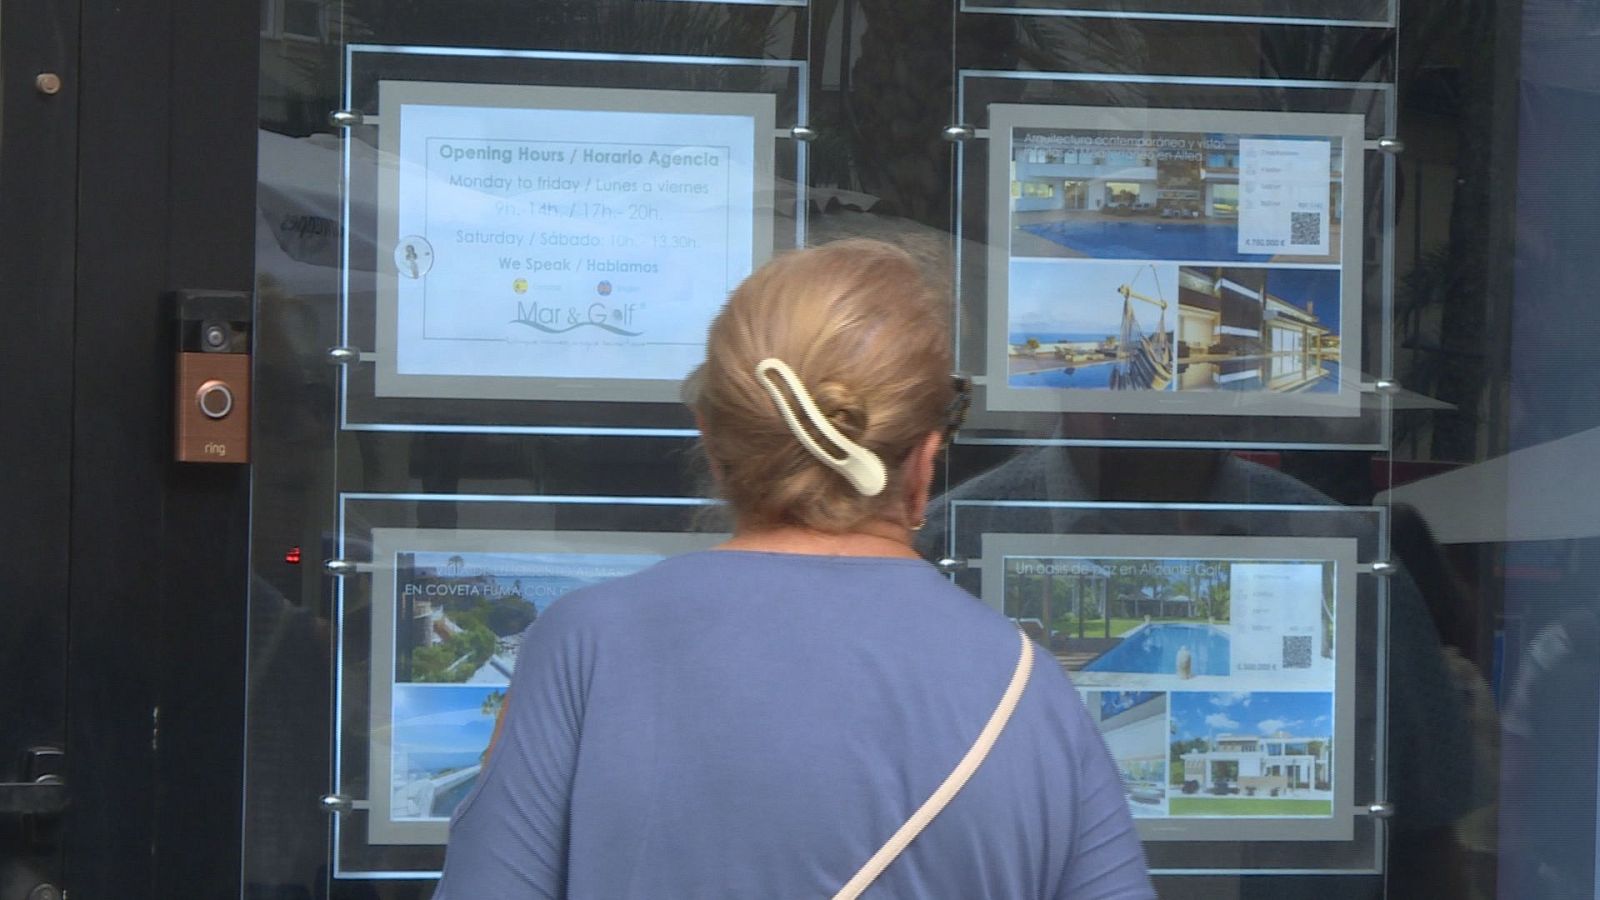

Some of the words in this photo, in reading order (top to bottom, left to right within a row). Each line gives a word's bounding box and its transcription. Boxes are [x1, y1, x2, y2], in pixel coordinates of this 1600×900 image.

[1198, 137, 1227, 149] vistas
[439, 144, 513, 164] Opening
[518, 147, 565, 163] Hours
[583, 149, 644, 165] Horario
[649, 151, 720, 169] Agencia
[1173, 151, 1203, 162] Altea
[449, 174, 513, 191] Monday
[517, 176, 533, 189] to
[537, 176, 580, 193] friday
[595, 179, 638, 193] Lunes
[642, 182, 652, 193] a
[657, 181, 710, 195] viernes
[455, 230, 524, 248] Saturday
[498, 257, 521, 271] We
[525, 258, 571, 274] Speak
[586, 259, 659, 274] Hablamos
[516, 301, 562, 324] Mar
[566, 306, 581, 325] &
[204, 442, 226, 457] ring
[1015, 563, 1033, 575] Un
[1036, 562, 1069, 576] oasis
[1071, 562, 1090, 576] de
[1119, 565, 1137, 576] en
[1139, 563, 1191, 577] Alicante
[1194, 564, 1222, 577] Golf
[404, 584, 423, 597] EN
[425, 584, 480, 597] COVETA
[483, 585, 520, 598] FUMA
